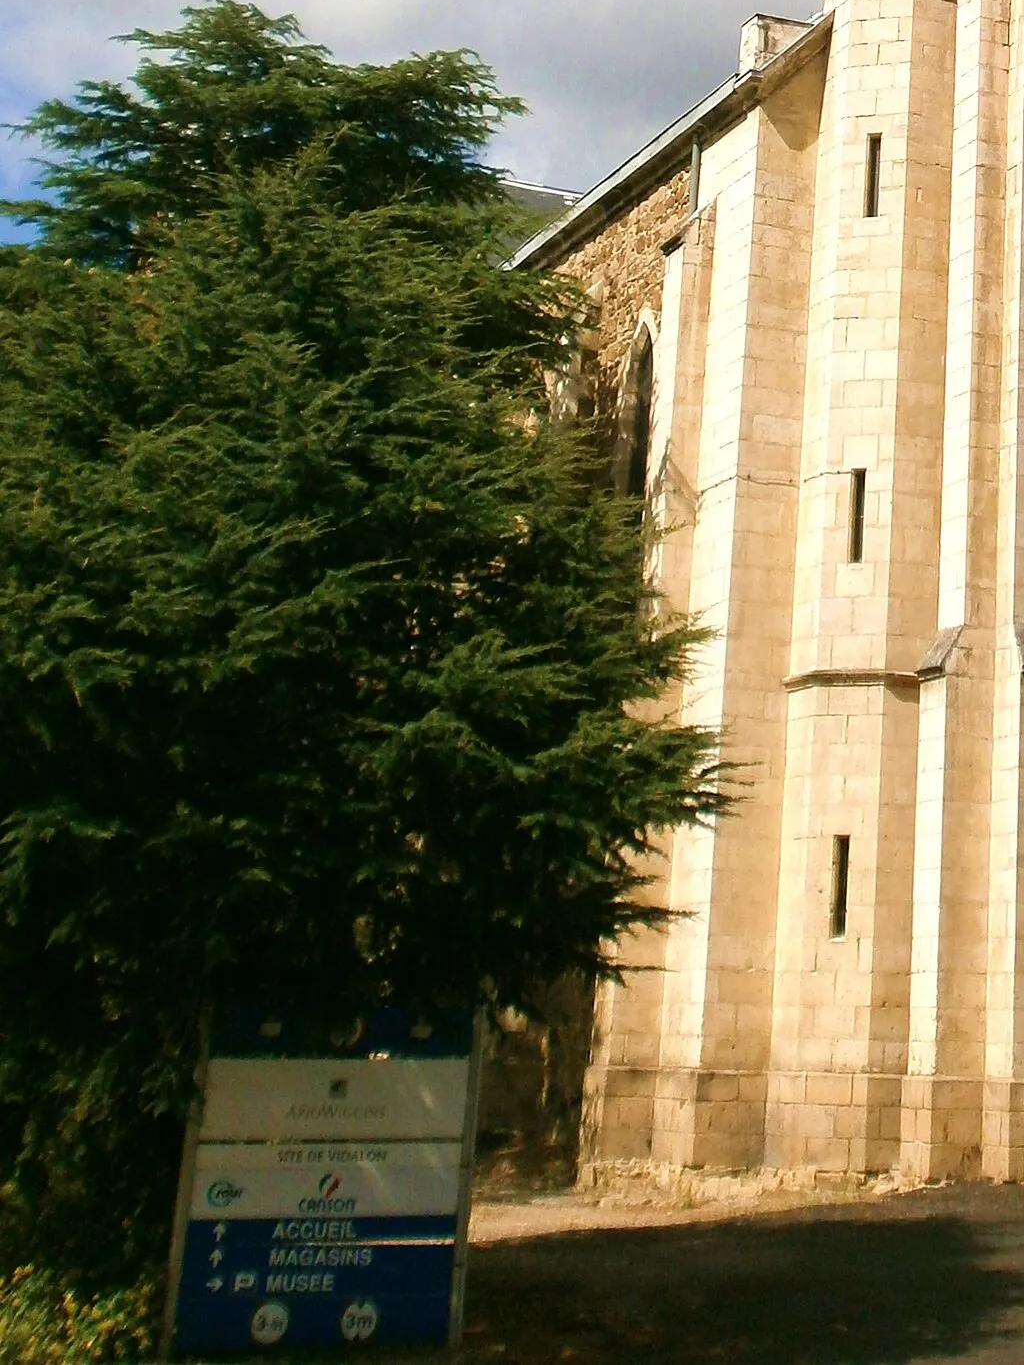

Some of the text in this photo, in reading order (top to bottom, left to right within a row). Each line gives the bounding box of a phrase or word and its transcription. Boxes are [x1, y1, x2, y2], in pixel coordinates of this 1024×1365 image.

[277, 1150, 302, 1163] SITE
[307, 1150, 324, 1163] DE
[272, 1220, 356, 1239] ACCUEIL
[268, 1247, 373, 1267] MAGASINS
